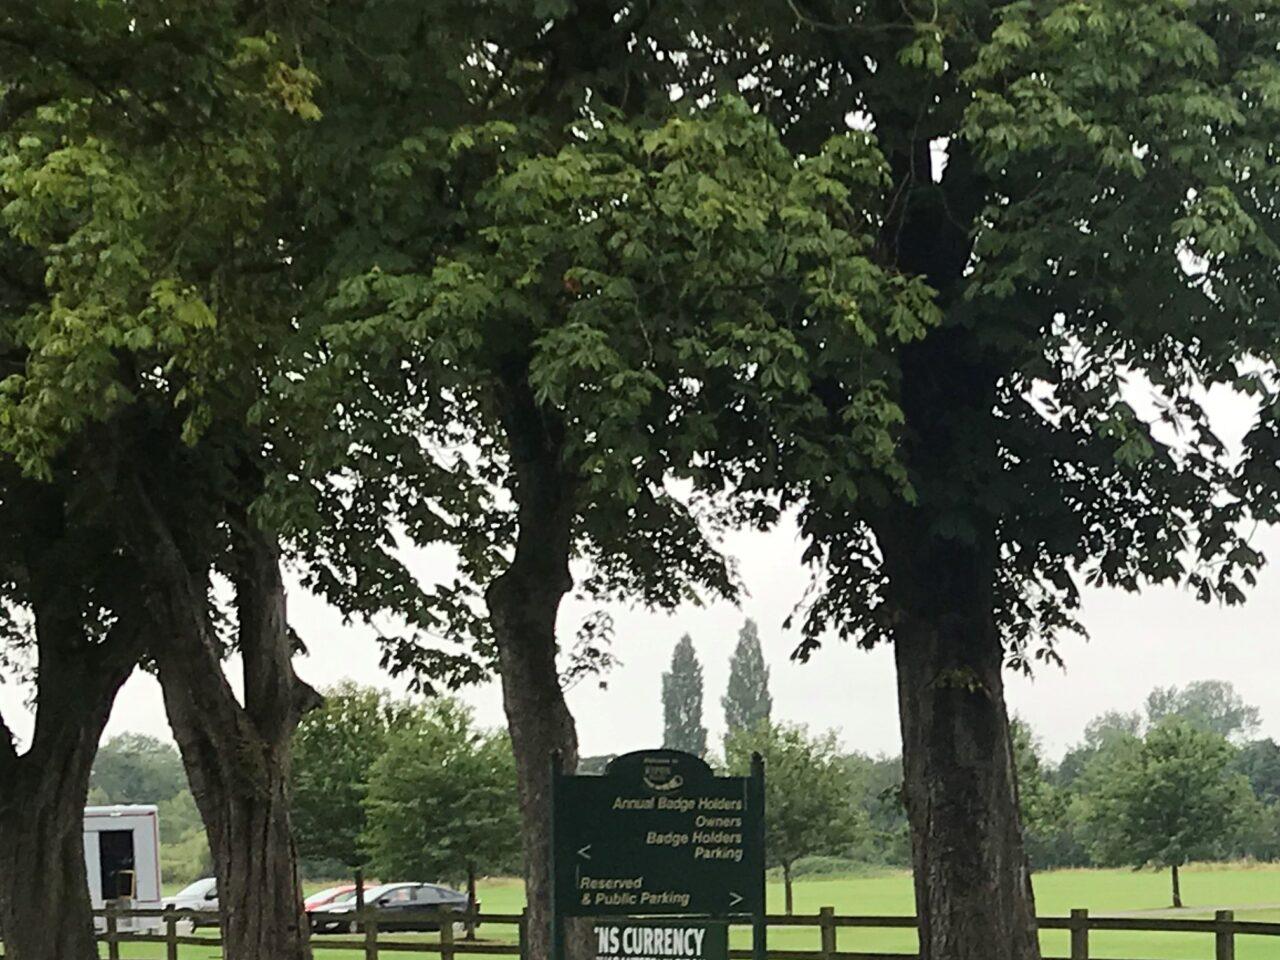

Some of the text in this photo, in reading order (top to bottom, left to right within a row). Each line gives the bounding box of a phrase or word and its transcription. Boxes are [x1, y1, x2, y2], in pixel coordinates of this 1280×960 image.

[612, 797, 742, 813] Annual Badge Holders
[695, 815, 742, 828] Owners
[646, 832, 742, 845] Badge Holders
[694, 847, 743, 862] Parking
[580, 876, 643, 889] Reserved
[581, 892, 690, 907] & Public Parking
[594, 926, 706, 956] NS CURRENCY
